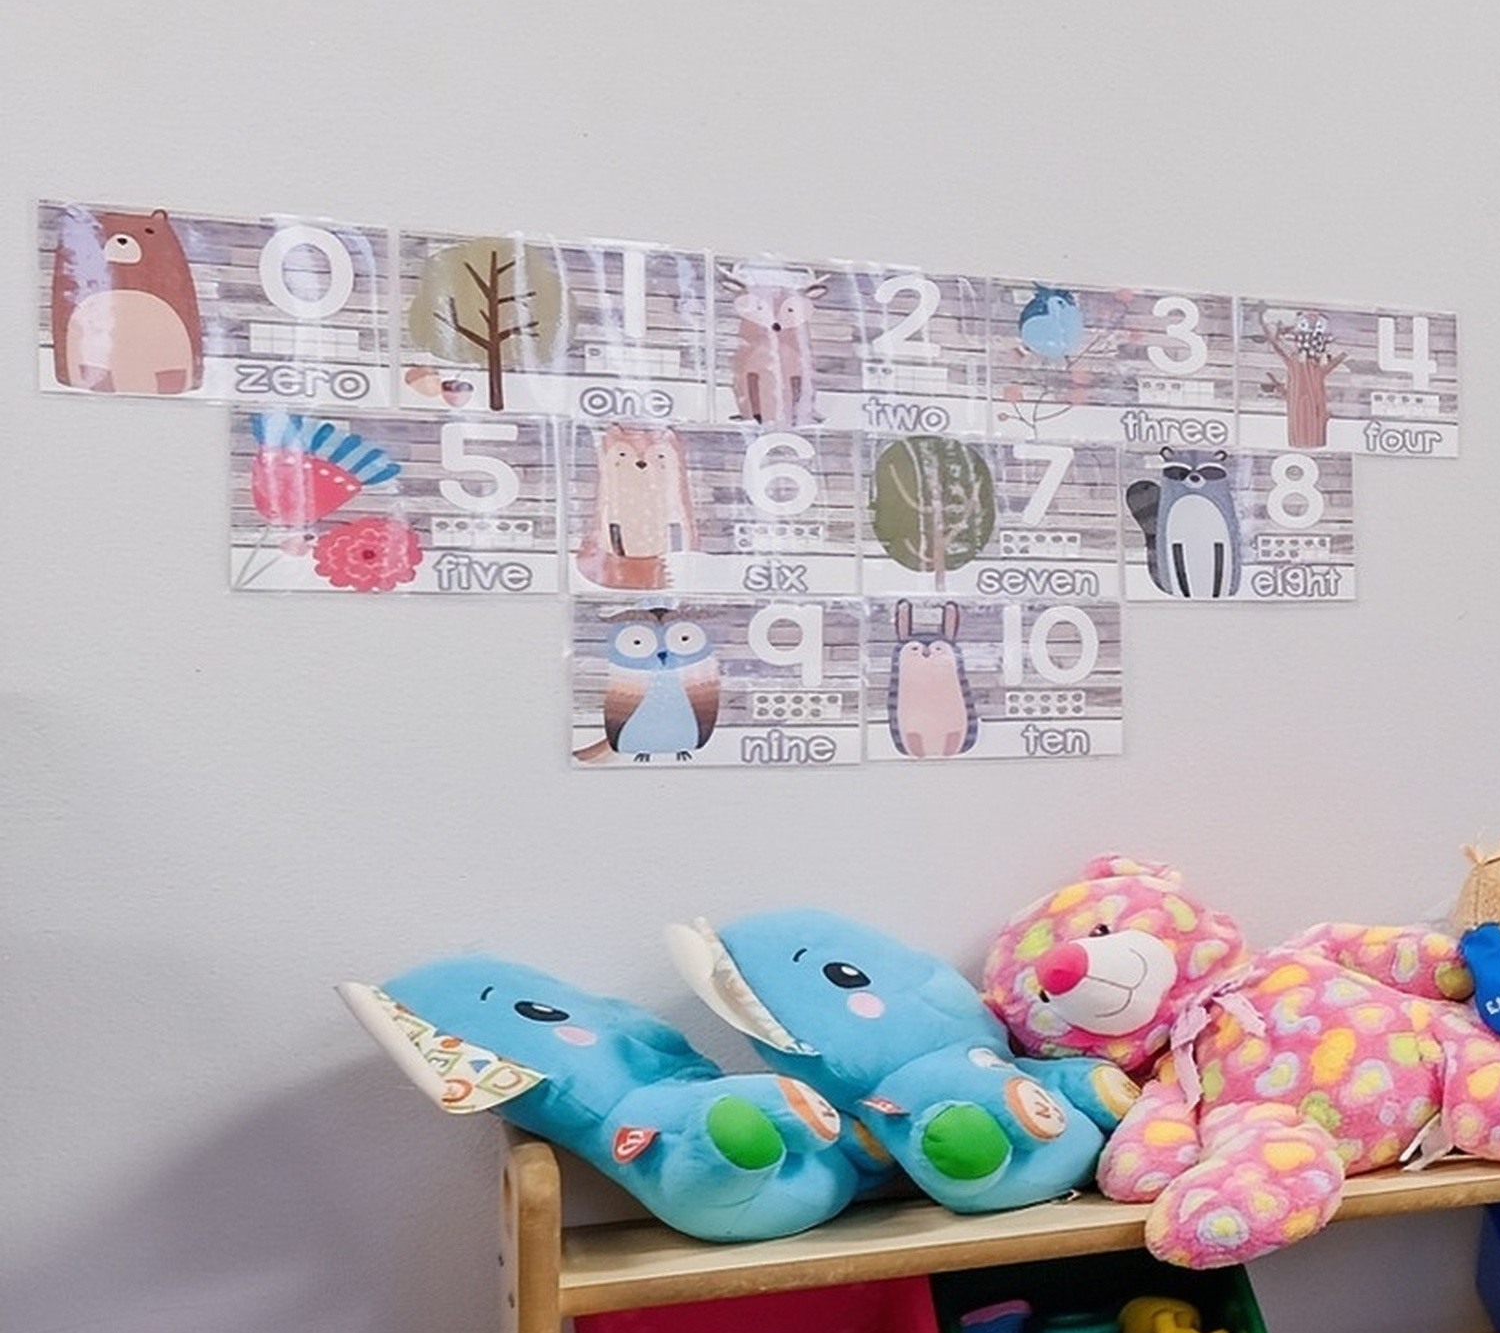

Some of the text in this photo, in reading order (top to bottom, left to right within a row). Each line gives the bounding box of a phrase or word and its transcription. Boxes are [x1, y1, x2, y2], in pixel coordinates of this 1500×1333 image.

[259, 225, 354, 319] 0
[873, 278, 942, 357] 2
[1146, 297, 1208, 376] 3
[1378, 316, 1438, 391] 4
[234, 362, 371, 401] zero
[579, 384, 674, 420] one
[862, 396, 950, 433] two
[1121, 408, 1229, 446] three
[1364, 419, 1443, 454] four
[439, 422, 521, 511] 5
[743, 433, 818, 516] 6
[1011, 444, 1075, 526] 7
[1266, 453, 1325, 529] 8
[432, 553, 534, 594] five
[742, 564, 809, 595] six
[977, 566, 1100, 597] seven
[1250, 563, 1342, 599] eight
[747, 603, 823, 687] 9
[1002, 604, 1100, 685] 10
[739, 727, 837, 766] nine
[1020, 721, 1091, 757] ten
